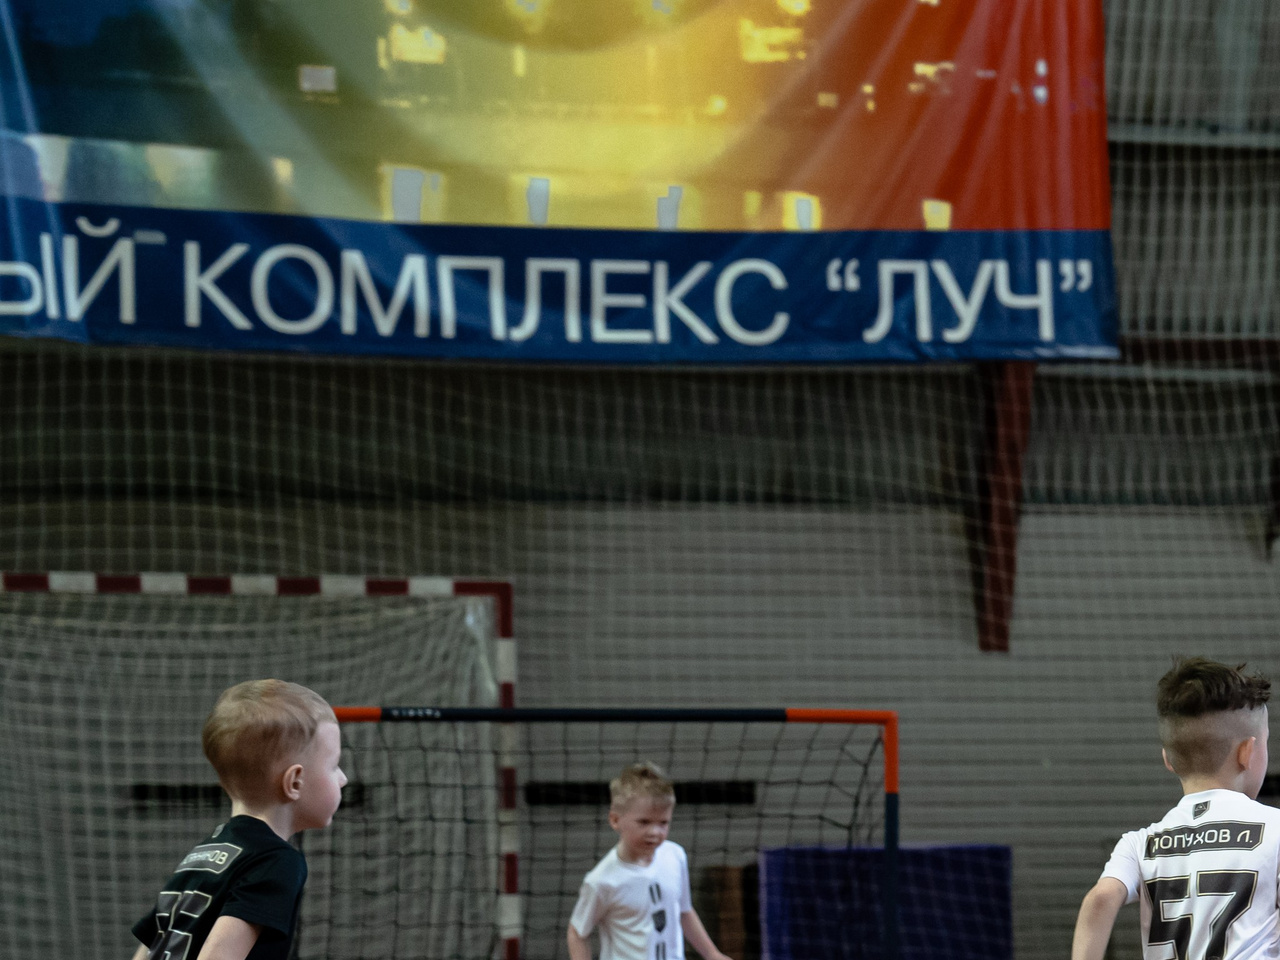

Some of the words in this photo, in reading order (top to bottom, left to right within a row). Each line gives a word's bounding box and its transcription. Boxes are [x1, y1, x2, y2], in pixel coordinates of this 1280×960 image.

[0, 216, 138, 324] ЫЙ
[184, 241, 792, 346] КОМПЛЕКС
[1236, 829, 1253, 843] Л.
